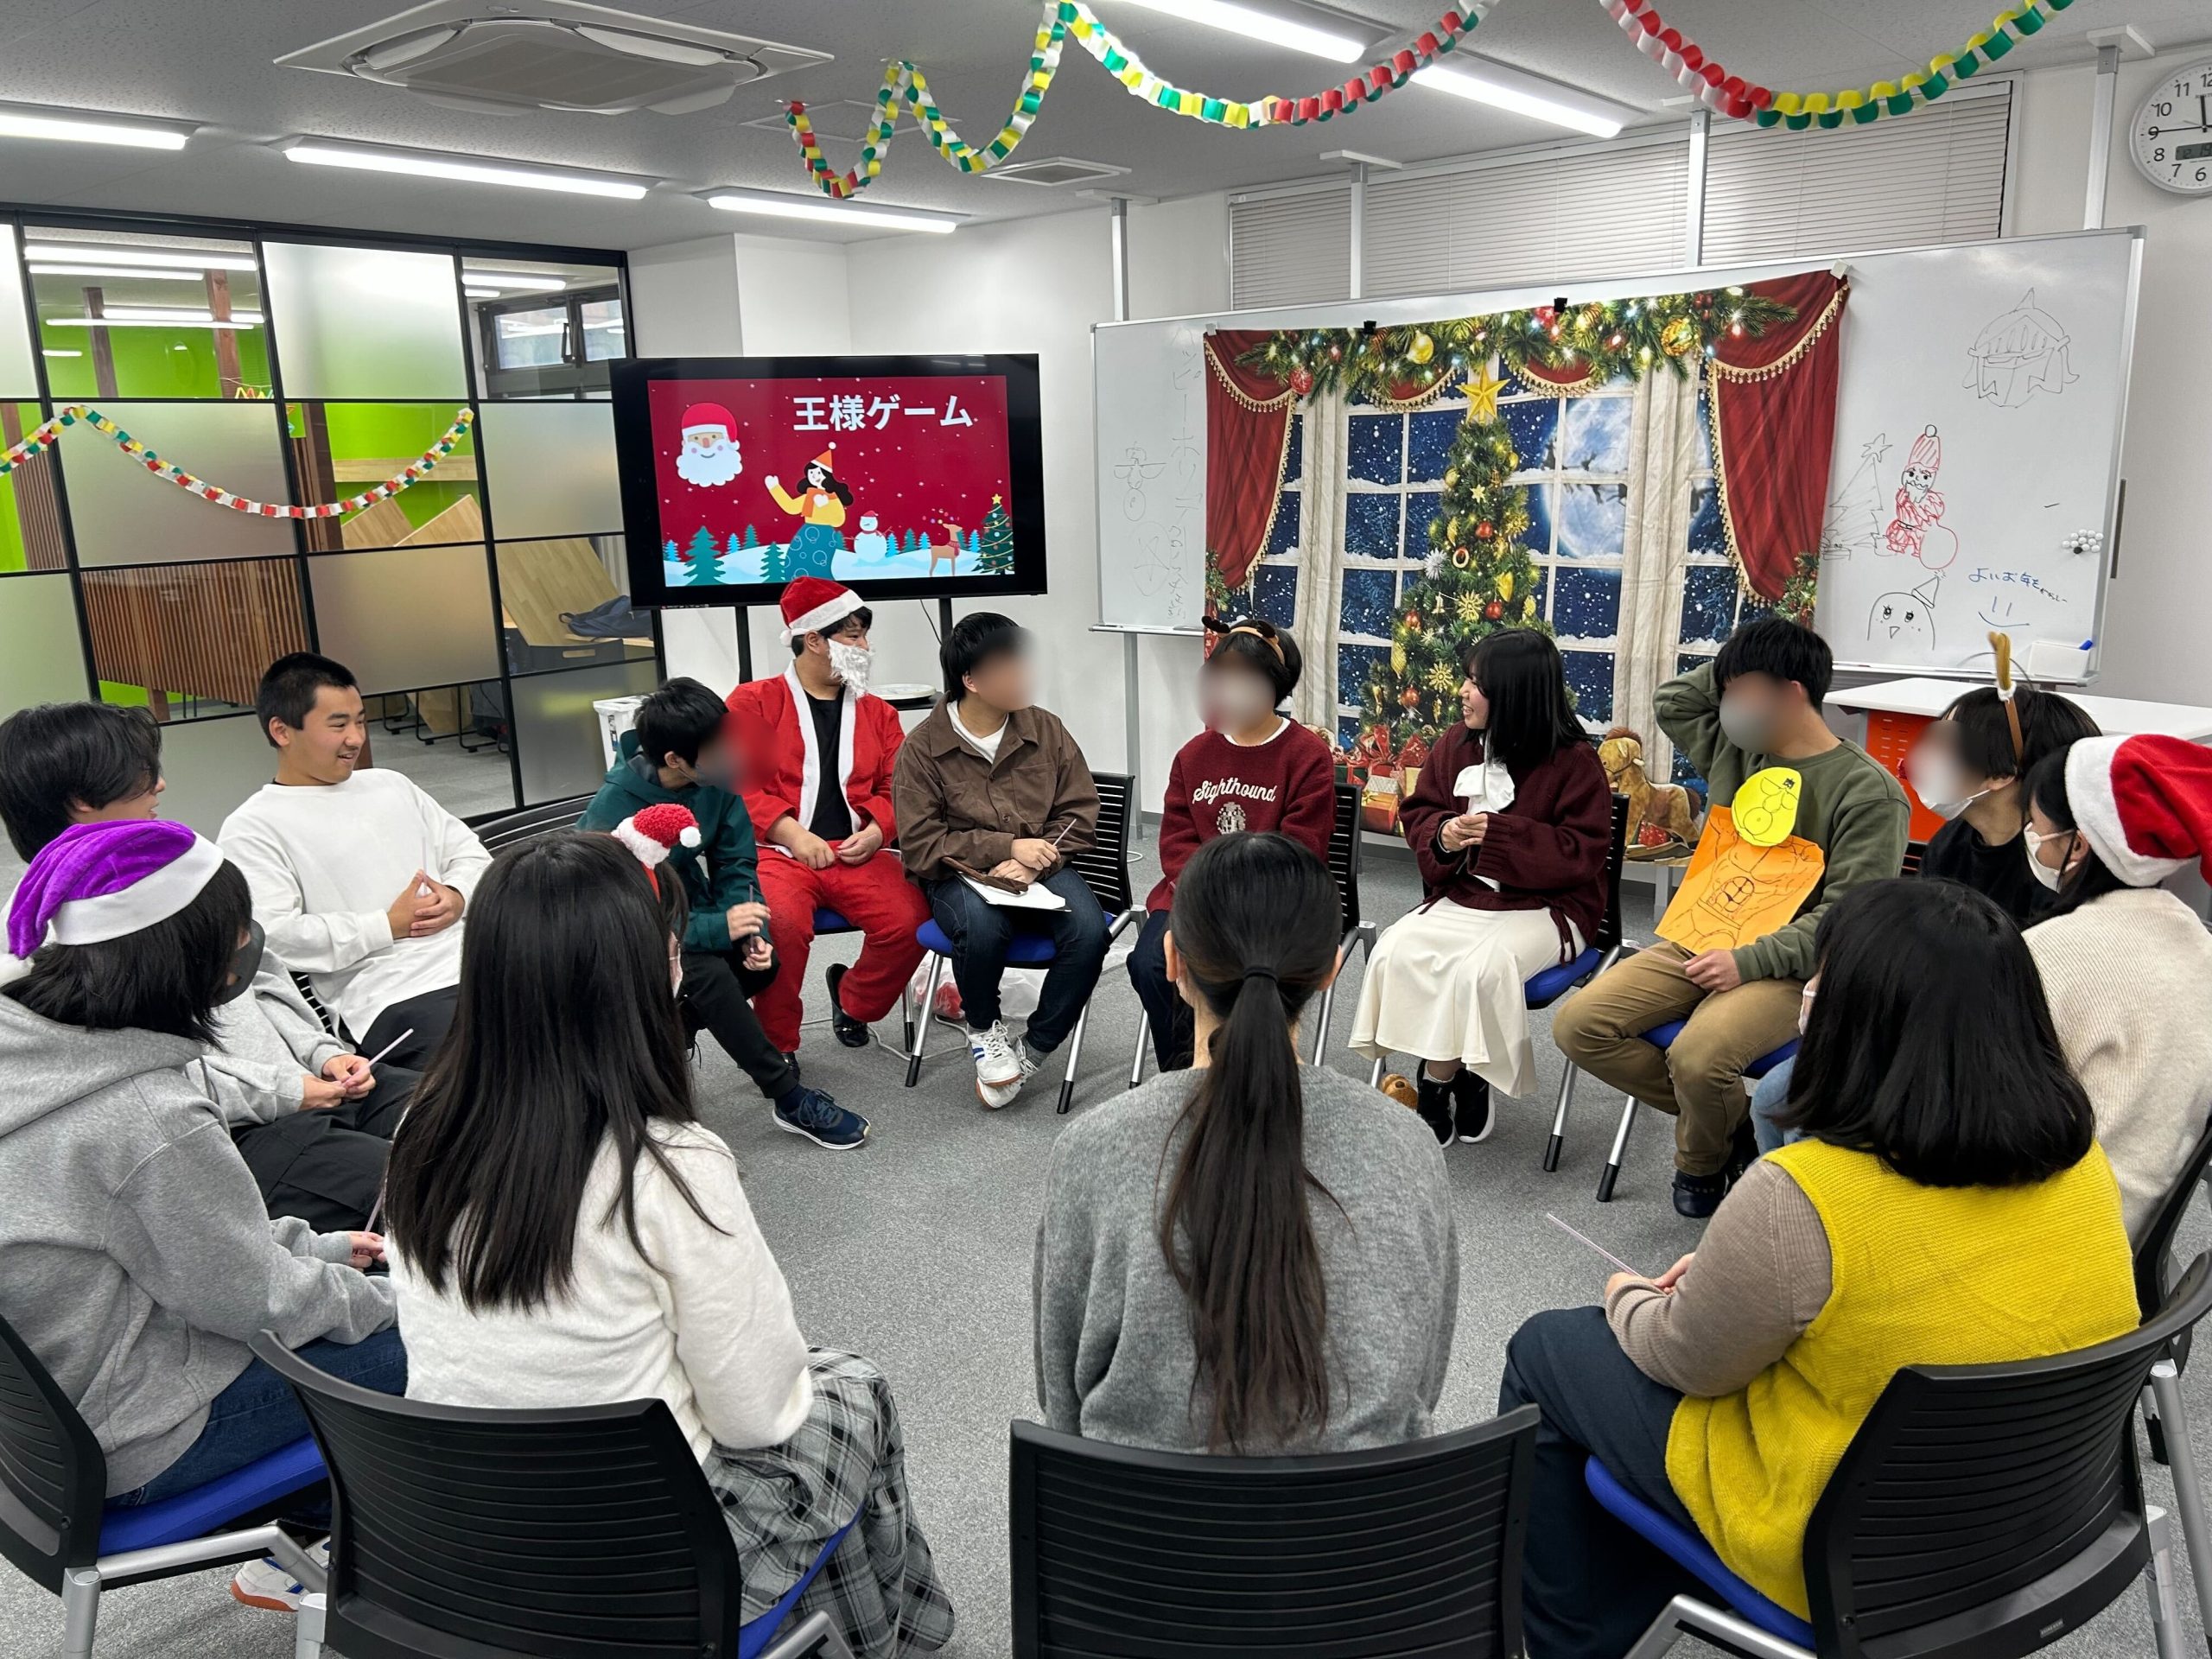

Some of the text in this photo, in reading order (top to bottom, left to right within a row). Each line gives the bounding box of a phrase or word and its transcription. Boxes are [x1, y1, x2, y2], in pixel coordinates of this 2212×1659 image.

[2174, 82, 2190, 97] 11
[2152, 102, 2172, 118] 10
[2148, 126, 2159, 140] 9
[2153, 148, 2164, 162] 8
[2171, 163, 2182, 178] 7
[2195, 167, 2206, 181] 6
[793, 393, 974, 432] 王様ゲーム
[1192, 777, 1277, 804] Sighthound
